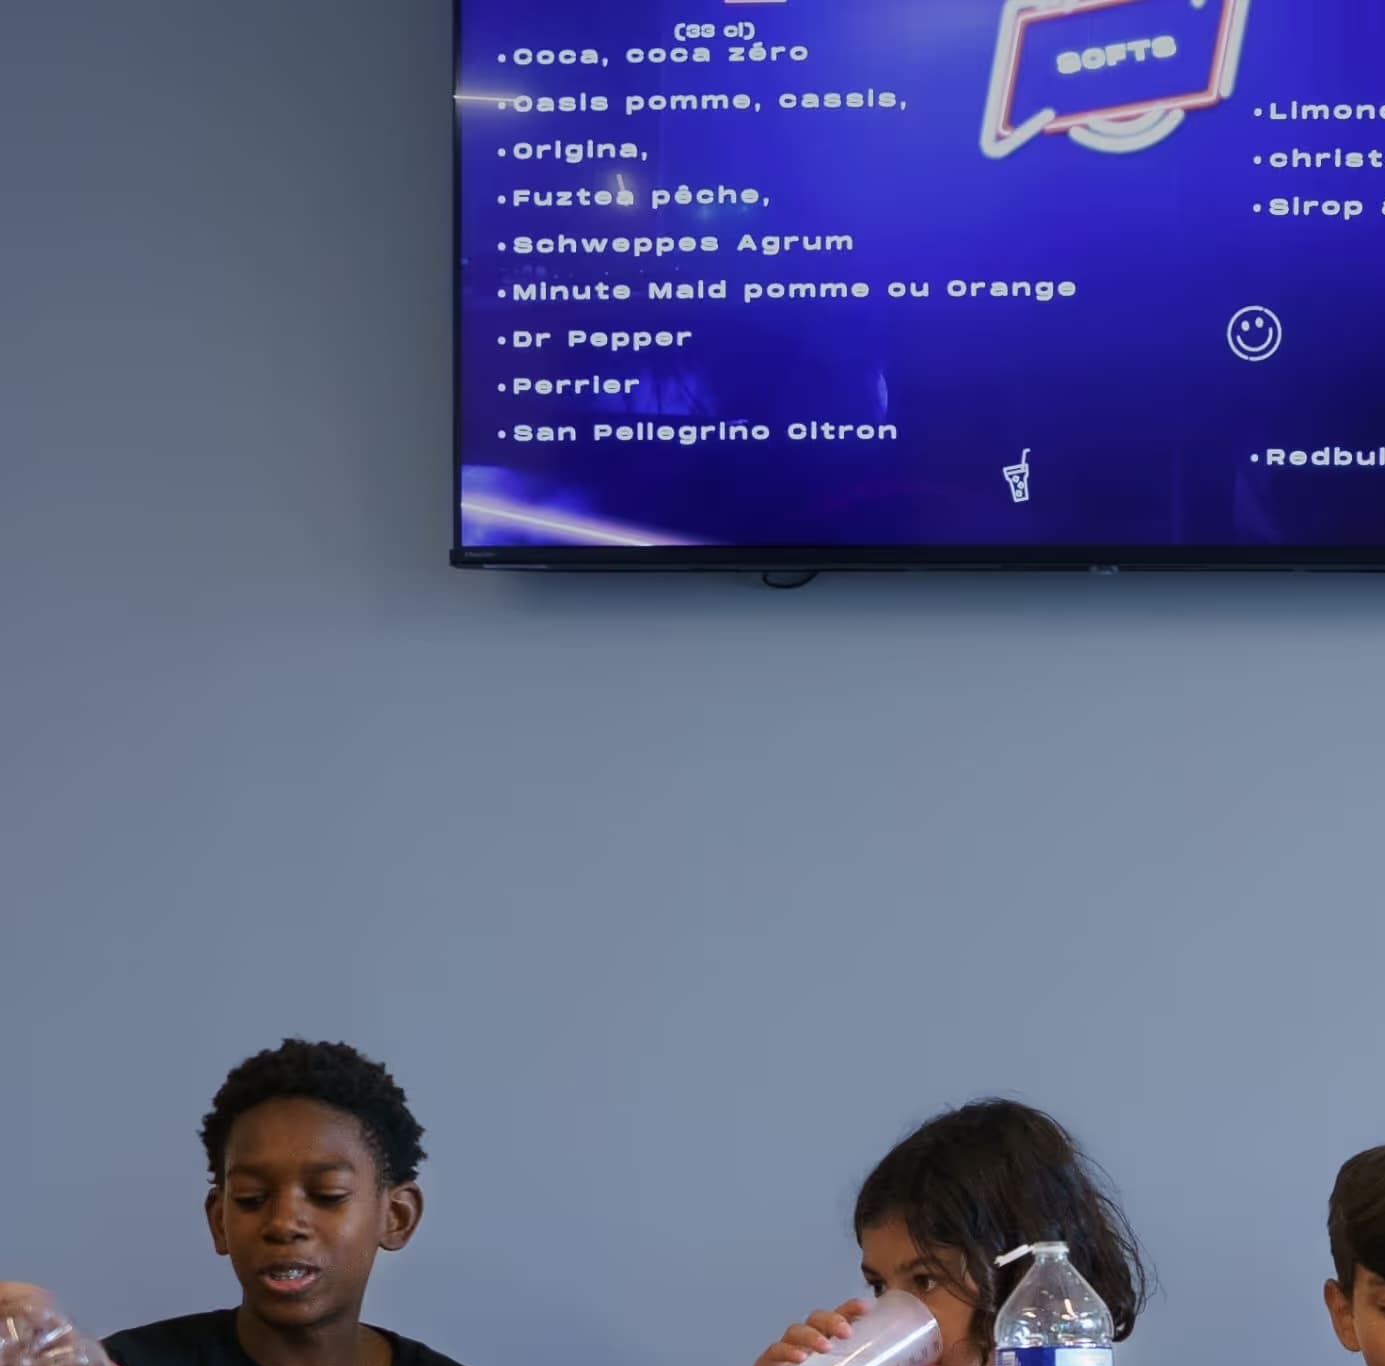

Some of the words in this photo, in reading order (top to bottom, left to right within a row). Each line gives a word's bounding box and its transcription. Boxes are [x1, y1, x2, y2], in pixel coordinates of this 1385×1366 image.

[673, 22, 716, 42] (33
[513, 48, 609, 67] Coca,
[626, 47, 711, 64] coca
[728, 41, 809, 62] zéro
[1057, 35, 1177, 74] SOFTS
[513, 92, 609, 113] Oasis
[625, 93, 761, 116] pomme,
[778, 88, 907, 111] cassis,
[513, 139, 648, 164] Origina,
[513, 185, 635, 207] Fuztea
[651, 184, 770, 210] pêche,
[1268, 196, 1363, 221] Sirop
[513, 234, 719, 257] Schweppes
[736, 234, 853, 256] Agrum
[513, 281, 631, 301] Minute
[648, 279, 727, 300] Maid
[744, 282, 870, 304] pomme
[887, 282, 929, 298] ou
[946, 279, 1076, 302] Orange
[513, 330, 551, 348] Dr
[568, 330, 692, 352] Pepper
[513, 375, 640, 395] Perrier
[513, 424, 577, 442] San
[593, 421, 770, 445] Pellegrino
[787, 421, 897, 440] Citron
